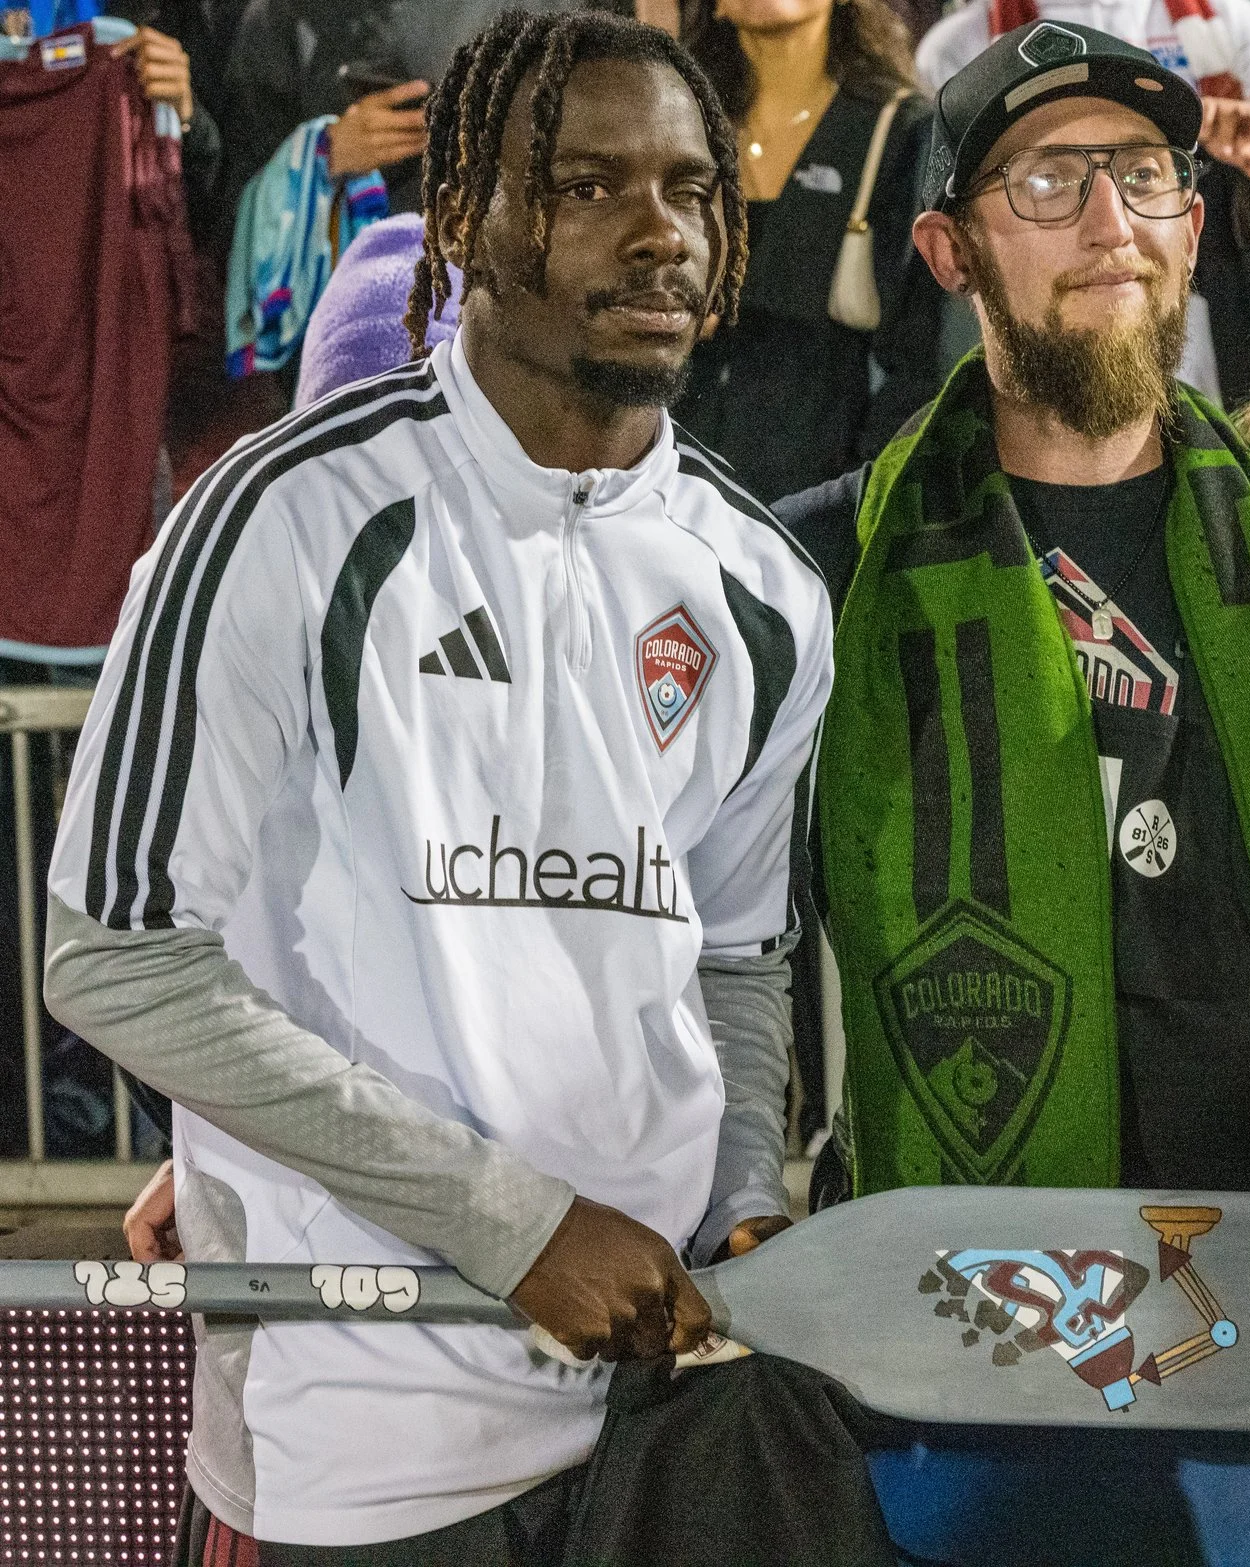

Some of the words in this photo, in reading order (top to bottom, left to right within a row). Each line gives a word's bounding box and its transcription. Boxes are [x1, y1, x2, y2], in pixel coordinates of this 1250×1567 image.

[645, 639, 702, 671] COLORADO
[655, 658, 687, 672] RAPIDS
[1151, 815, 1160, 831] R
[1131, 827, 1147, 842] 81
[1157, 836, 1169, 850] 26
[1145, 849, 1153, 864] S
[902, 971, 1042, 1019] COLORADO
[73, 1260, 188, 1309] STL
